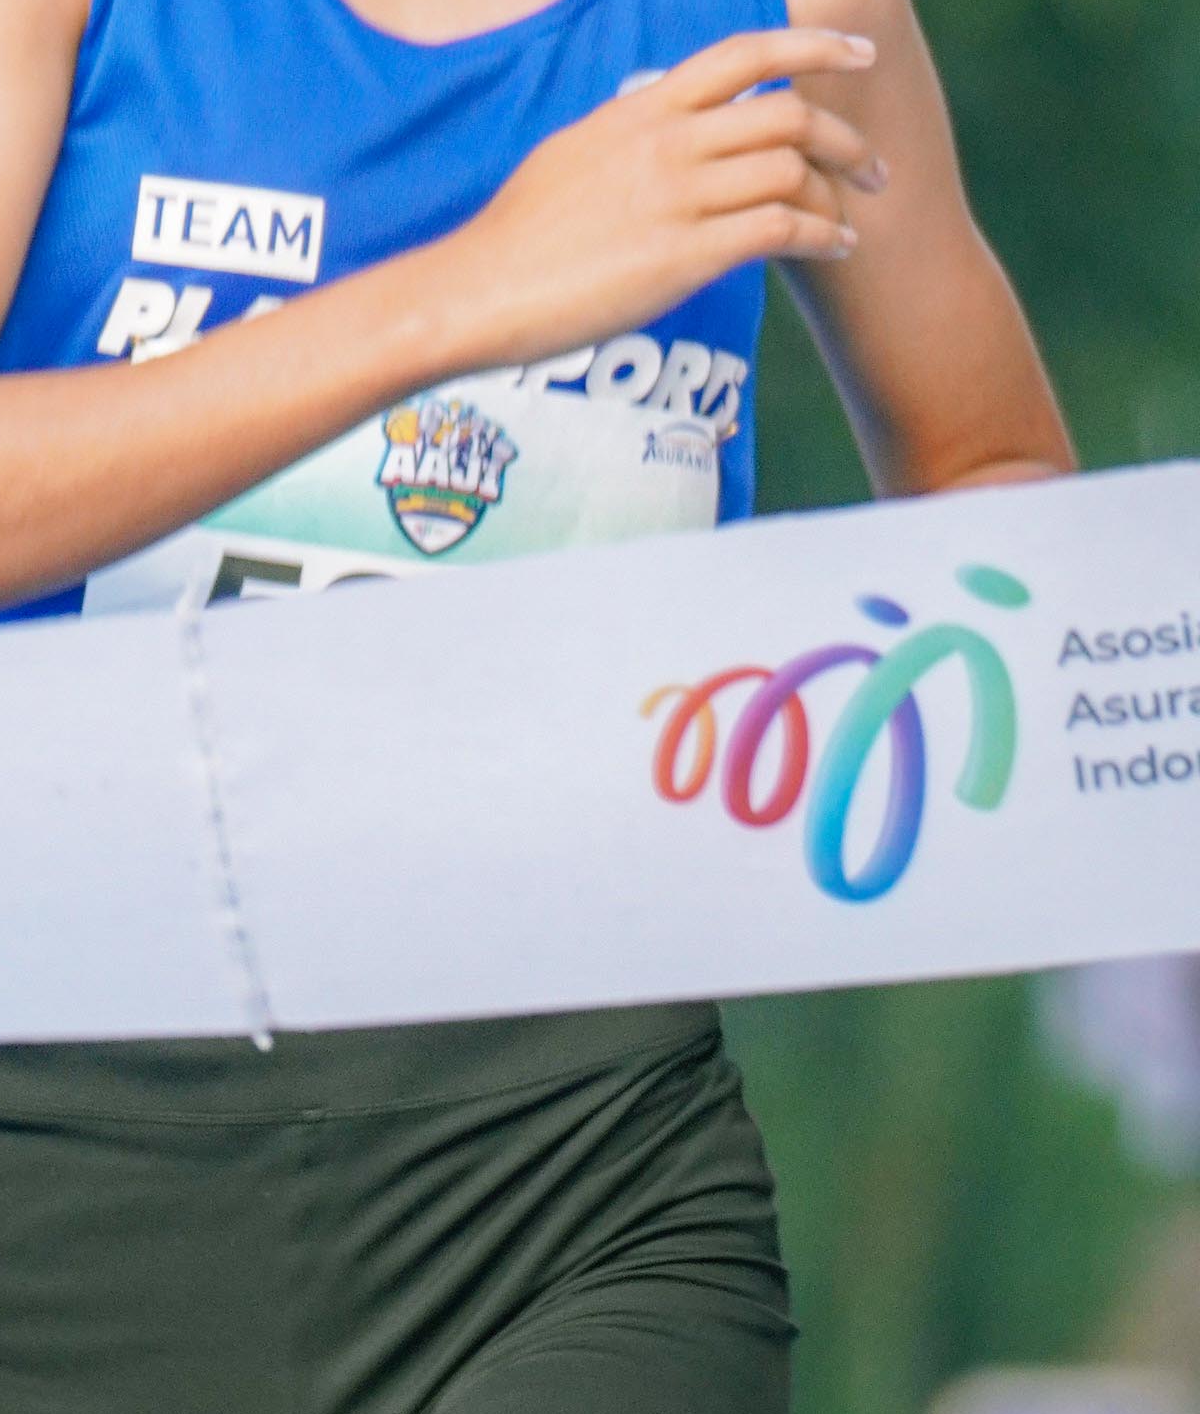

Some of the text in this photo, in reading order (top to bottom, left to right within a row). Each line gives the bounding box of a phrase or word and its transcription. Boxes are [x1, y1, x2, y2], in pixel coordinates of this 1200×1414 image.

[146, 191, 313, 260] TEAM
[1056, 611, 1200, 668] Asosi
[1073, 743, 1200, 794] Indo
